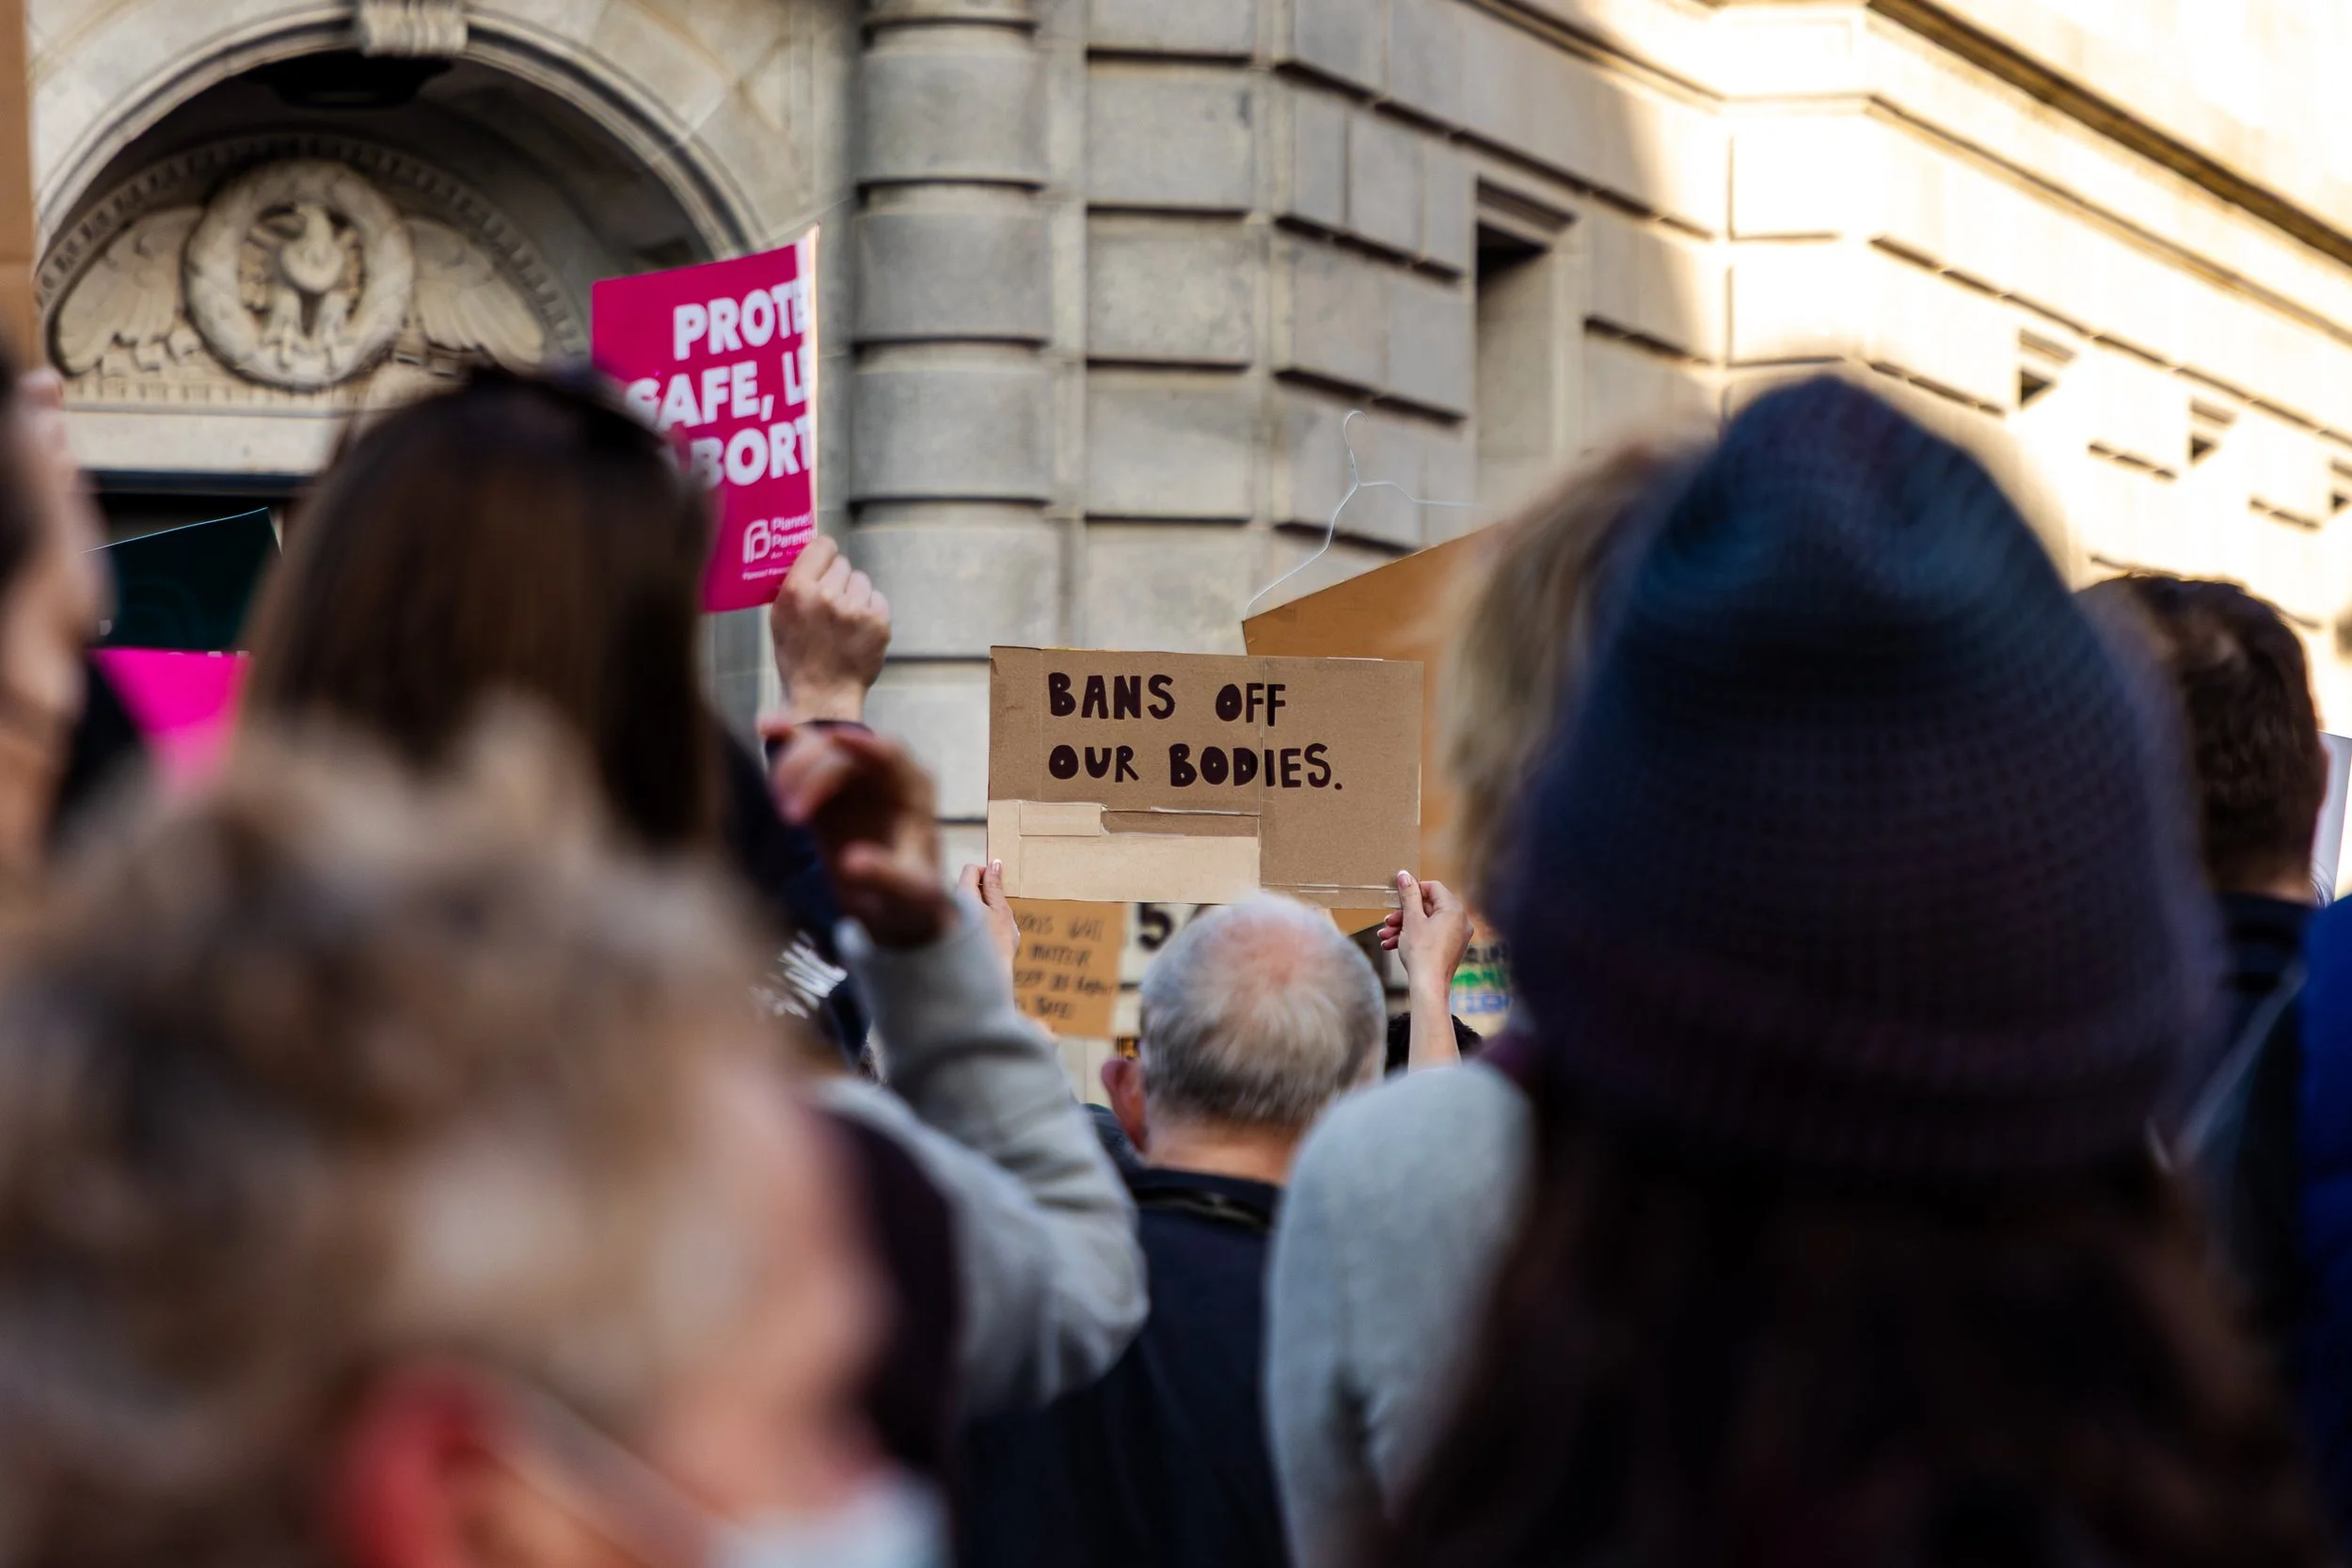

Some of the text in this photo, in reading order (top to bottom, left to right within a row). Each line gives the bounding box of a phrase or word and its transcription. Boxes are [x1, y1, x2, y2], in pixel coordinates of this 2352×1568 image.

[625, 360, 774, 431] SAFE,
[1048, 672, 1287, 727] BANS OFF
[1048, 743, 1343, 790] OUR BODIES.
